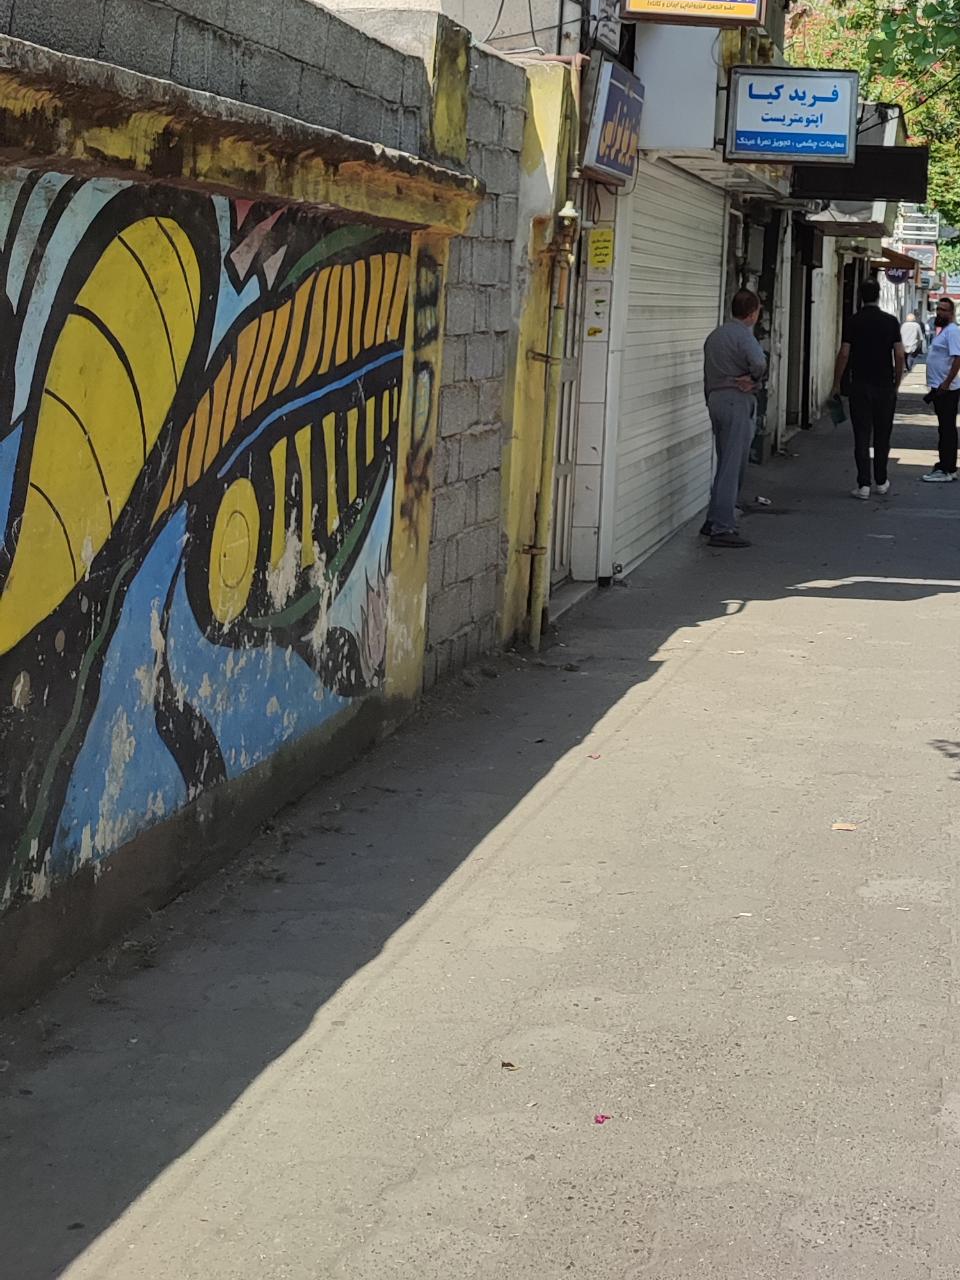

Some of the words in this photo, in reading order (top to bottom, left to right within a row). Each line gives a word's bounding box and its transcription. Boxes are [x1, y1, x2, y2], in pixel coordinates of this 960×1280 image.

[748, 82, 784, 104] کیا
[789, 84, 839, 107] فرید
[771, 139, 791, 147] تجویز
[797, 139, 817, 149] چشمی
